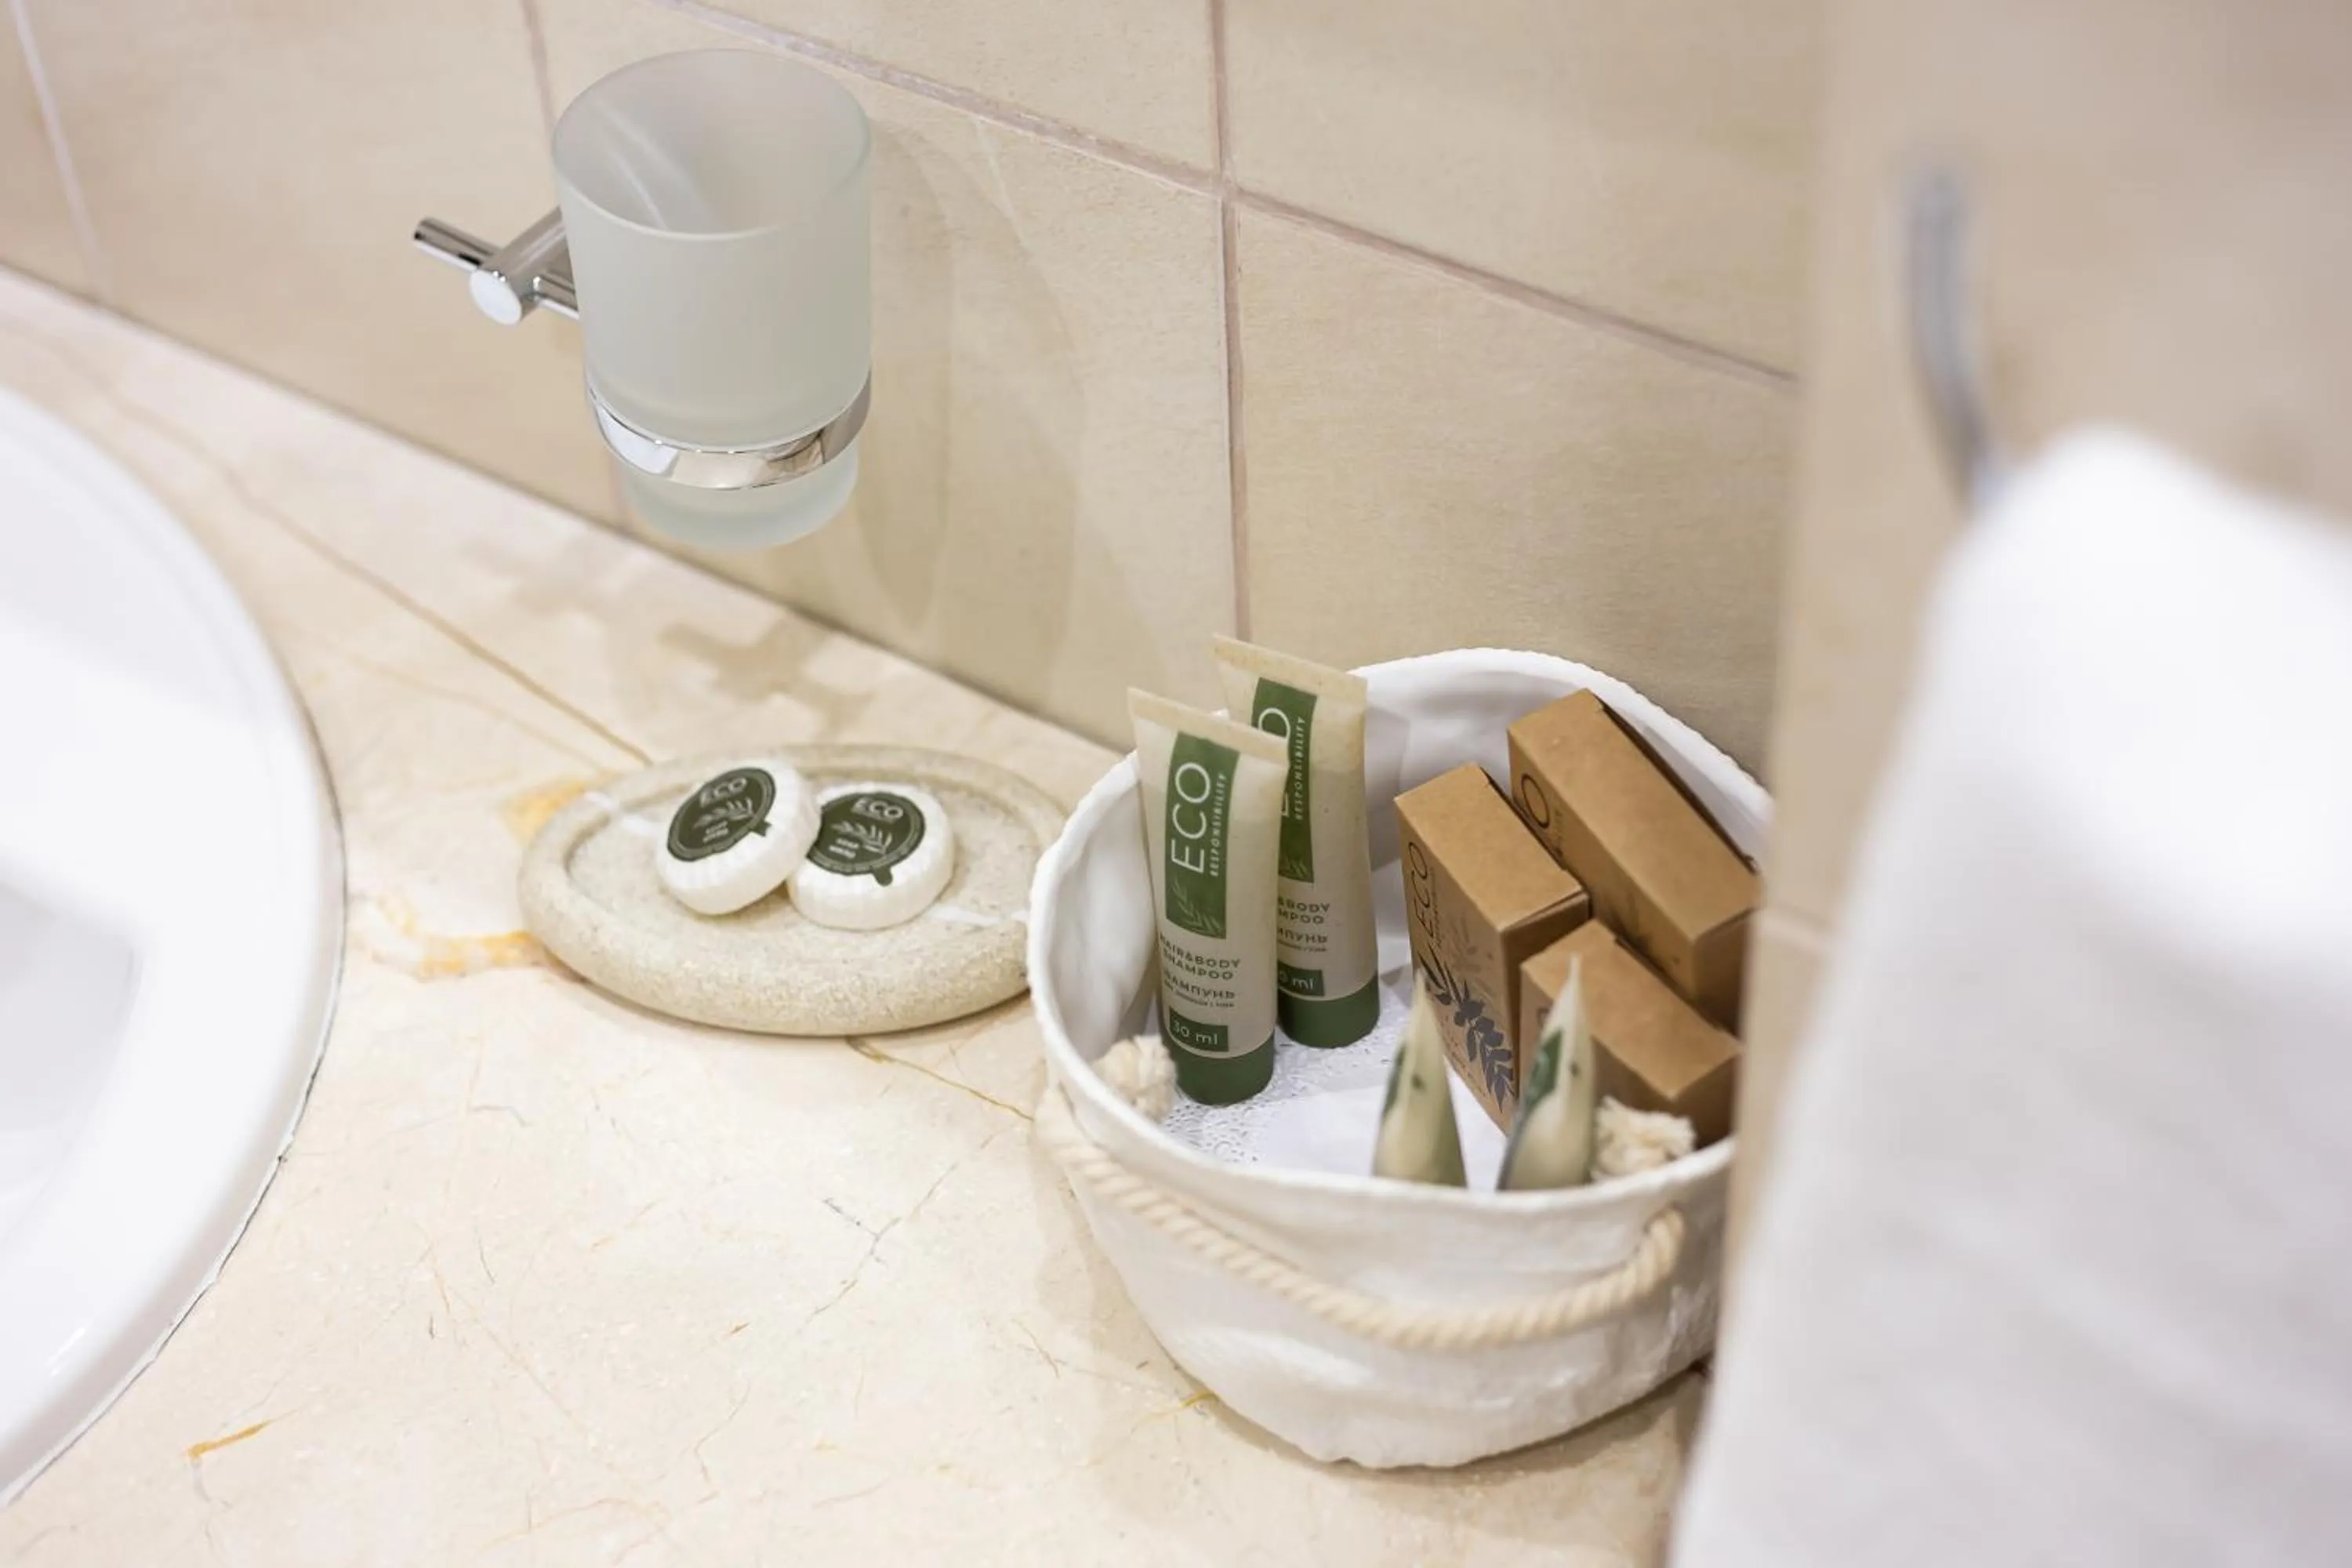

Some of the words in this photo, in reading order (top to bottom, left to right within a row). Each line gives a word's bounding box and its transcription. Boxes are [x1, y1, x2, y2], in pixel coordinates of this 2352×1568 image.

[699, 776, 748, 808] ECO
[851, 797, 904, 821] ECO
[1171, 762, 1211, 874] ECO
[1408, 841, 1434, 938] ECO
[1278, 896, 1330, 913] &BODY
[1278, 908, 1325, 924] MPOO
[1278, 927, 1328, 944] МПУНЬ
[1293, 978, 1316, 990] ml
[1195, 1032, 1218, 1046] ml
